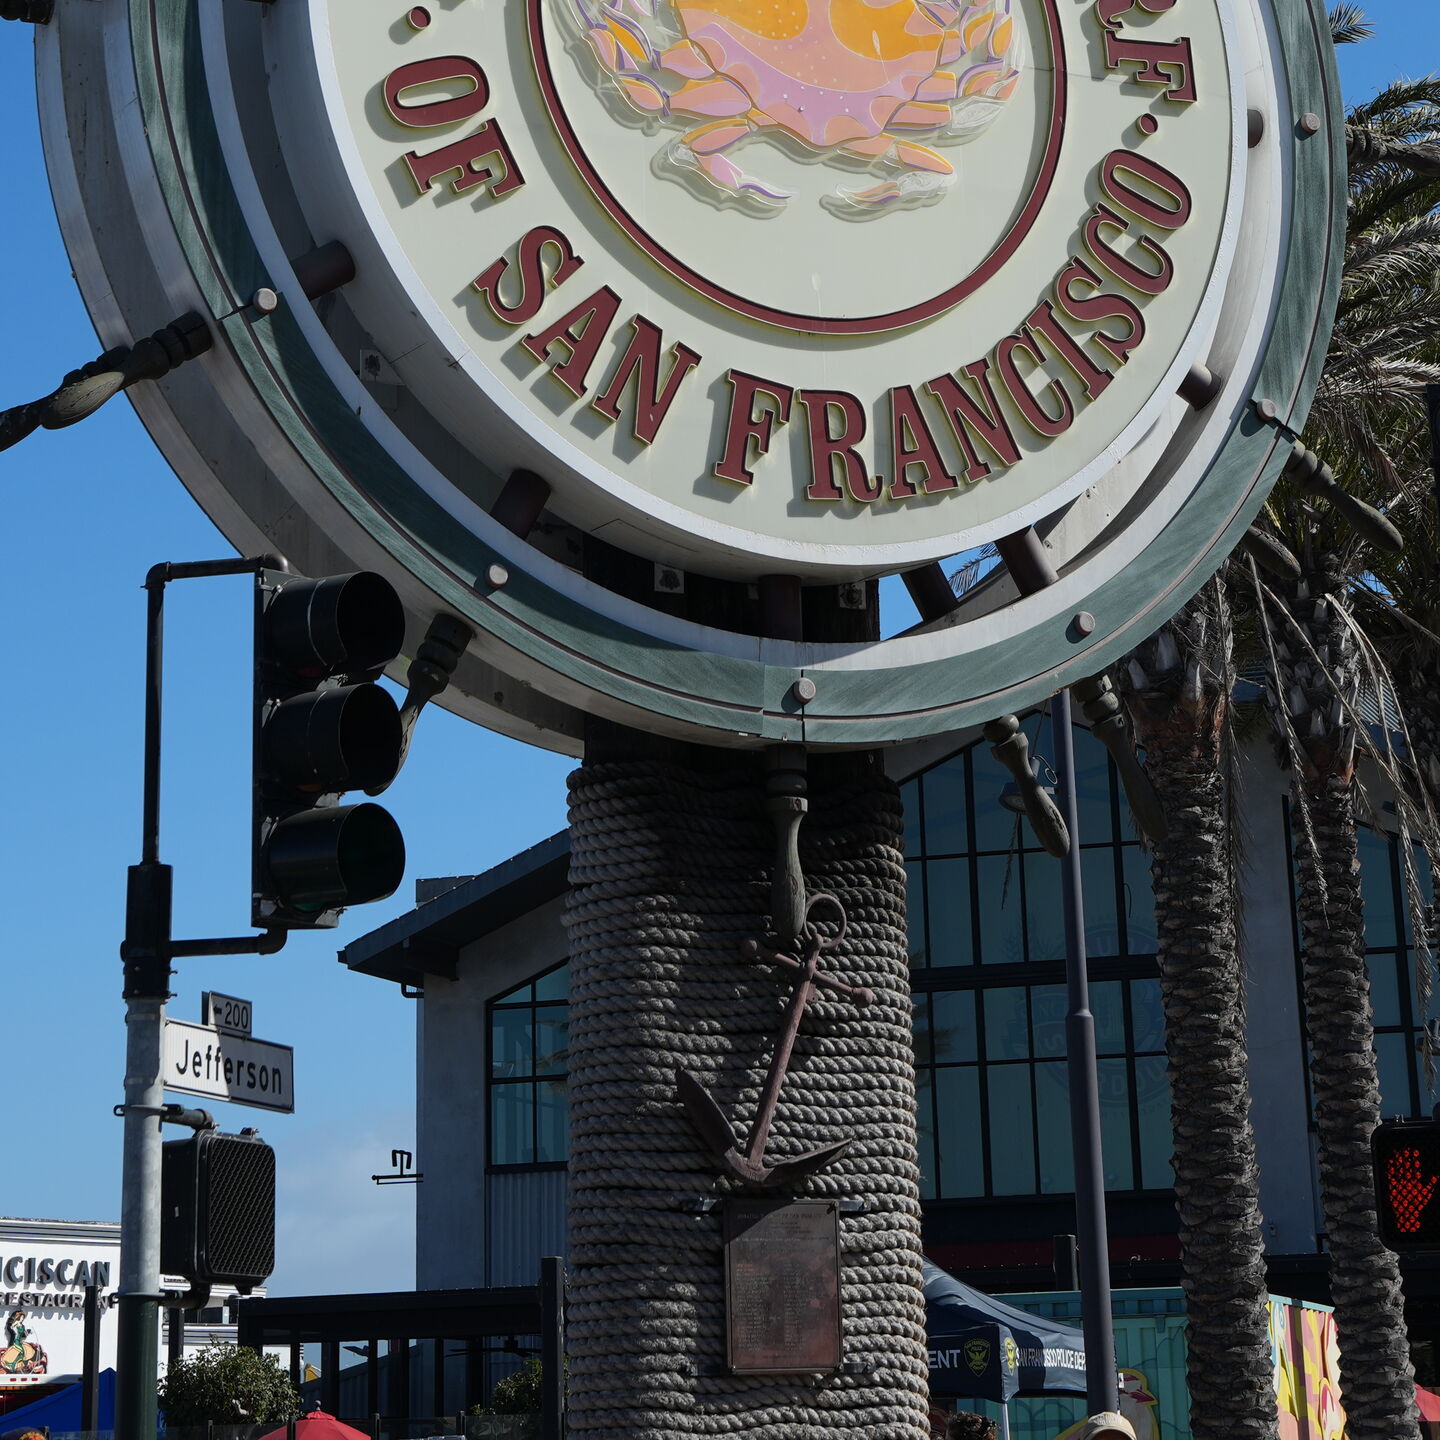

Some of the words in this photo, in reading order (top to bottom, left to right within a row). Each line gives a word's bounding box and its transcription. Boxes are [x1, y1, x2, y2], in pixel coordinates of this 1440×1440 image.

[382, 53, 529, 198] OF
[474, 224, 702, 447] SAN
[713, 147, 1193, 503] FRANCISCO
[224, 1001, 249, 1030] 200
[175, 1039, 282, 1095] Jefferson
